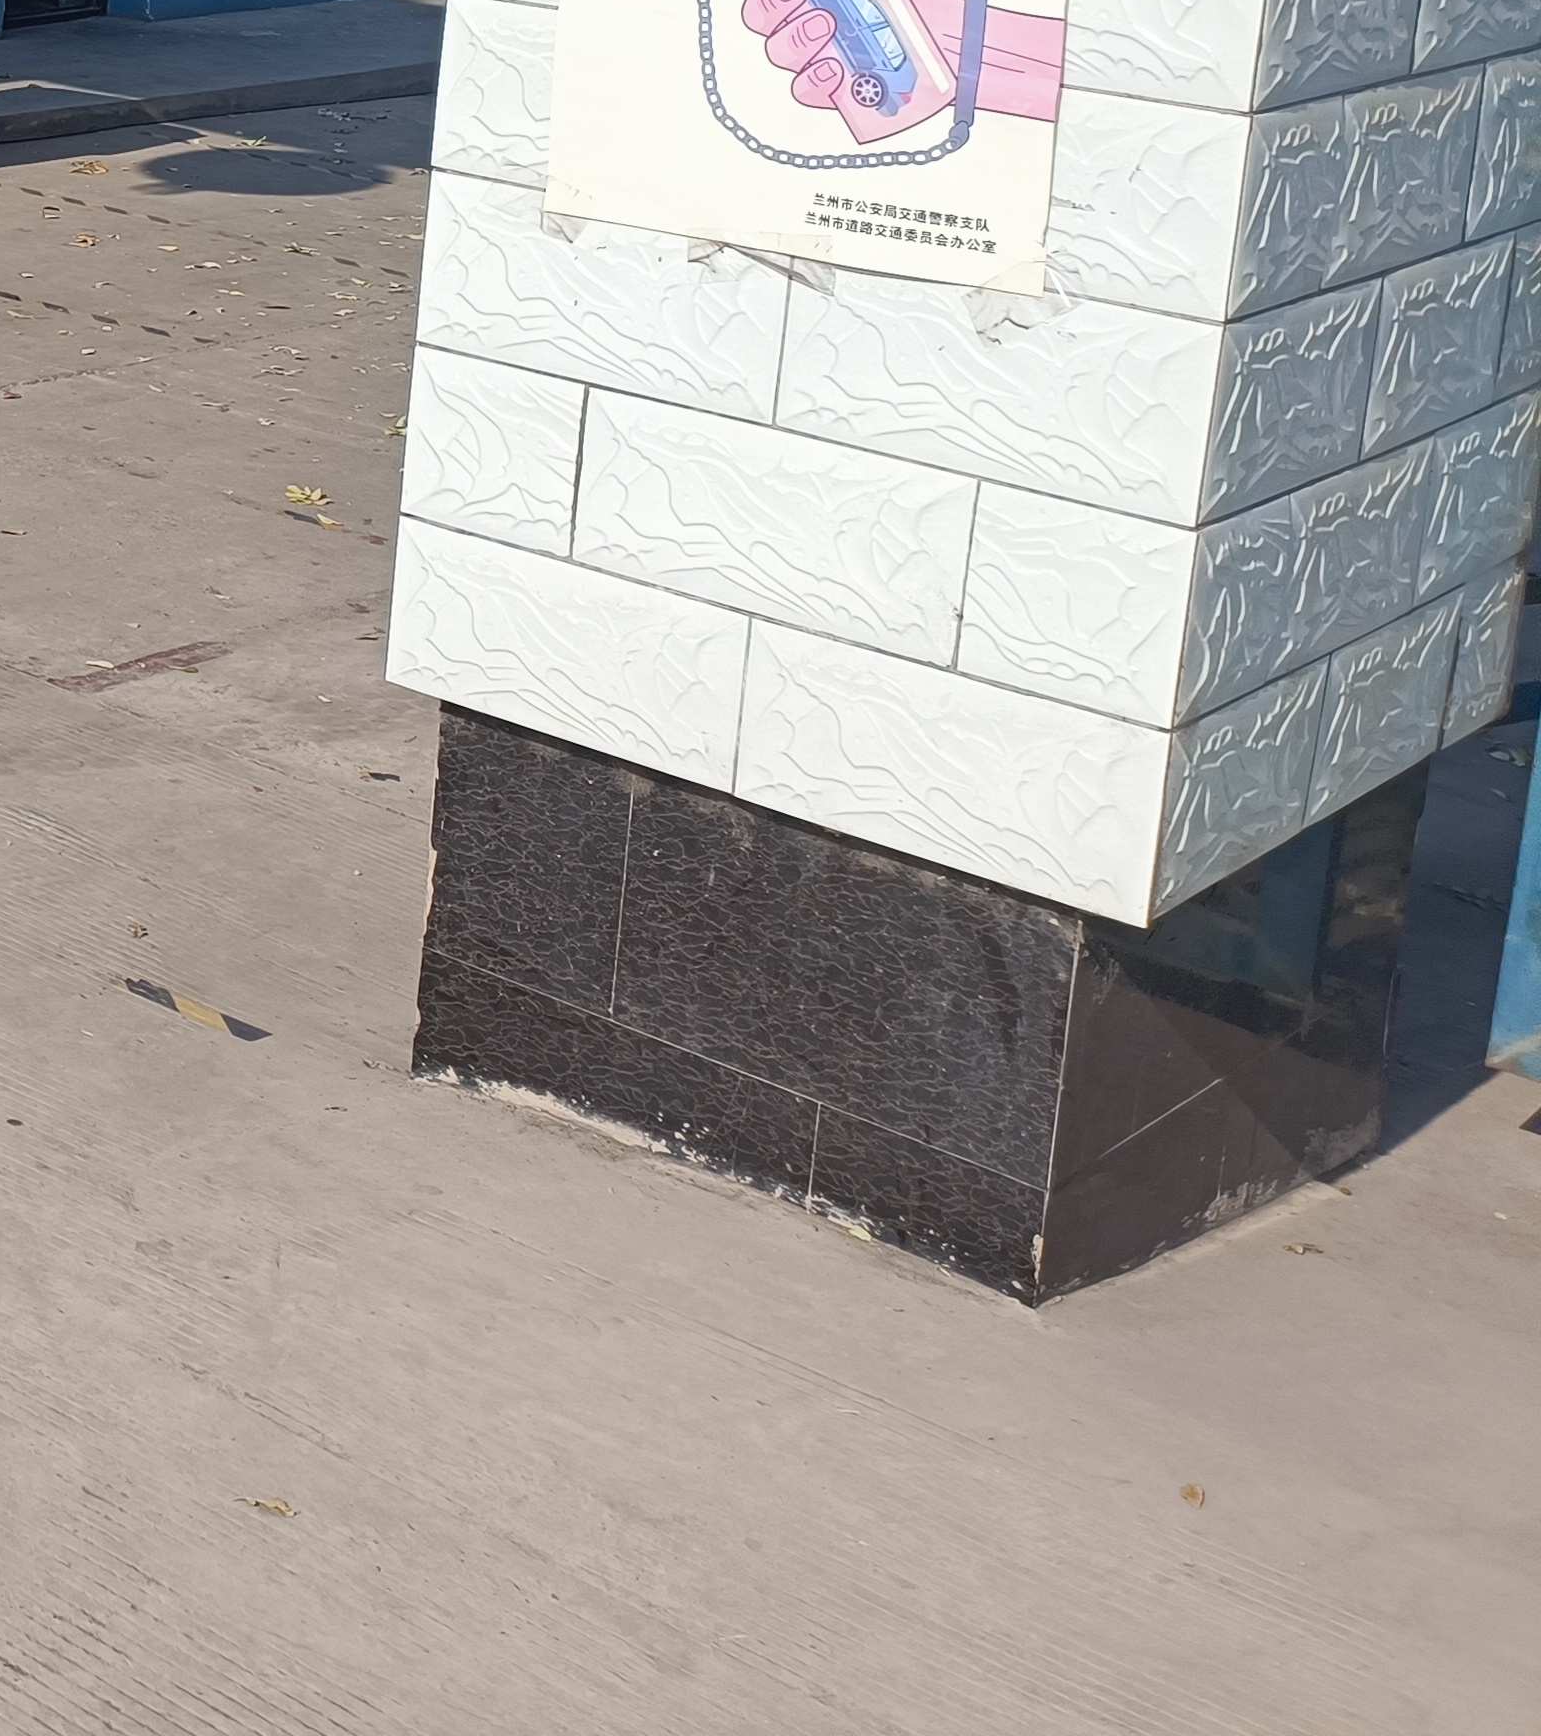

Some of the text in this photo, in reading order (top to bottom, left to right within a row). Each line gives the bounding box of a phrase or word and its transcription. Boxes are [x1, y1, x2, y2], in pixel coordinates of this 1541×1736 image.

[804, 210, 998, 255] 兰州市道路交通委员会办公室
[812, 192, 991, 233] 兰州市公安局交通警察支队
